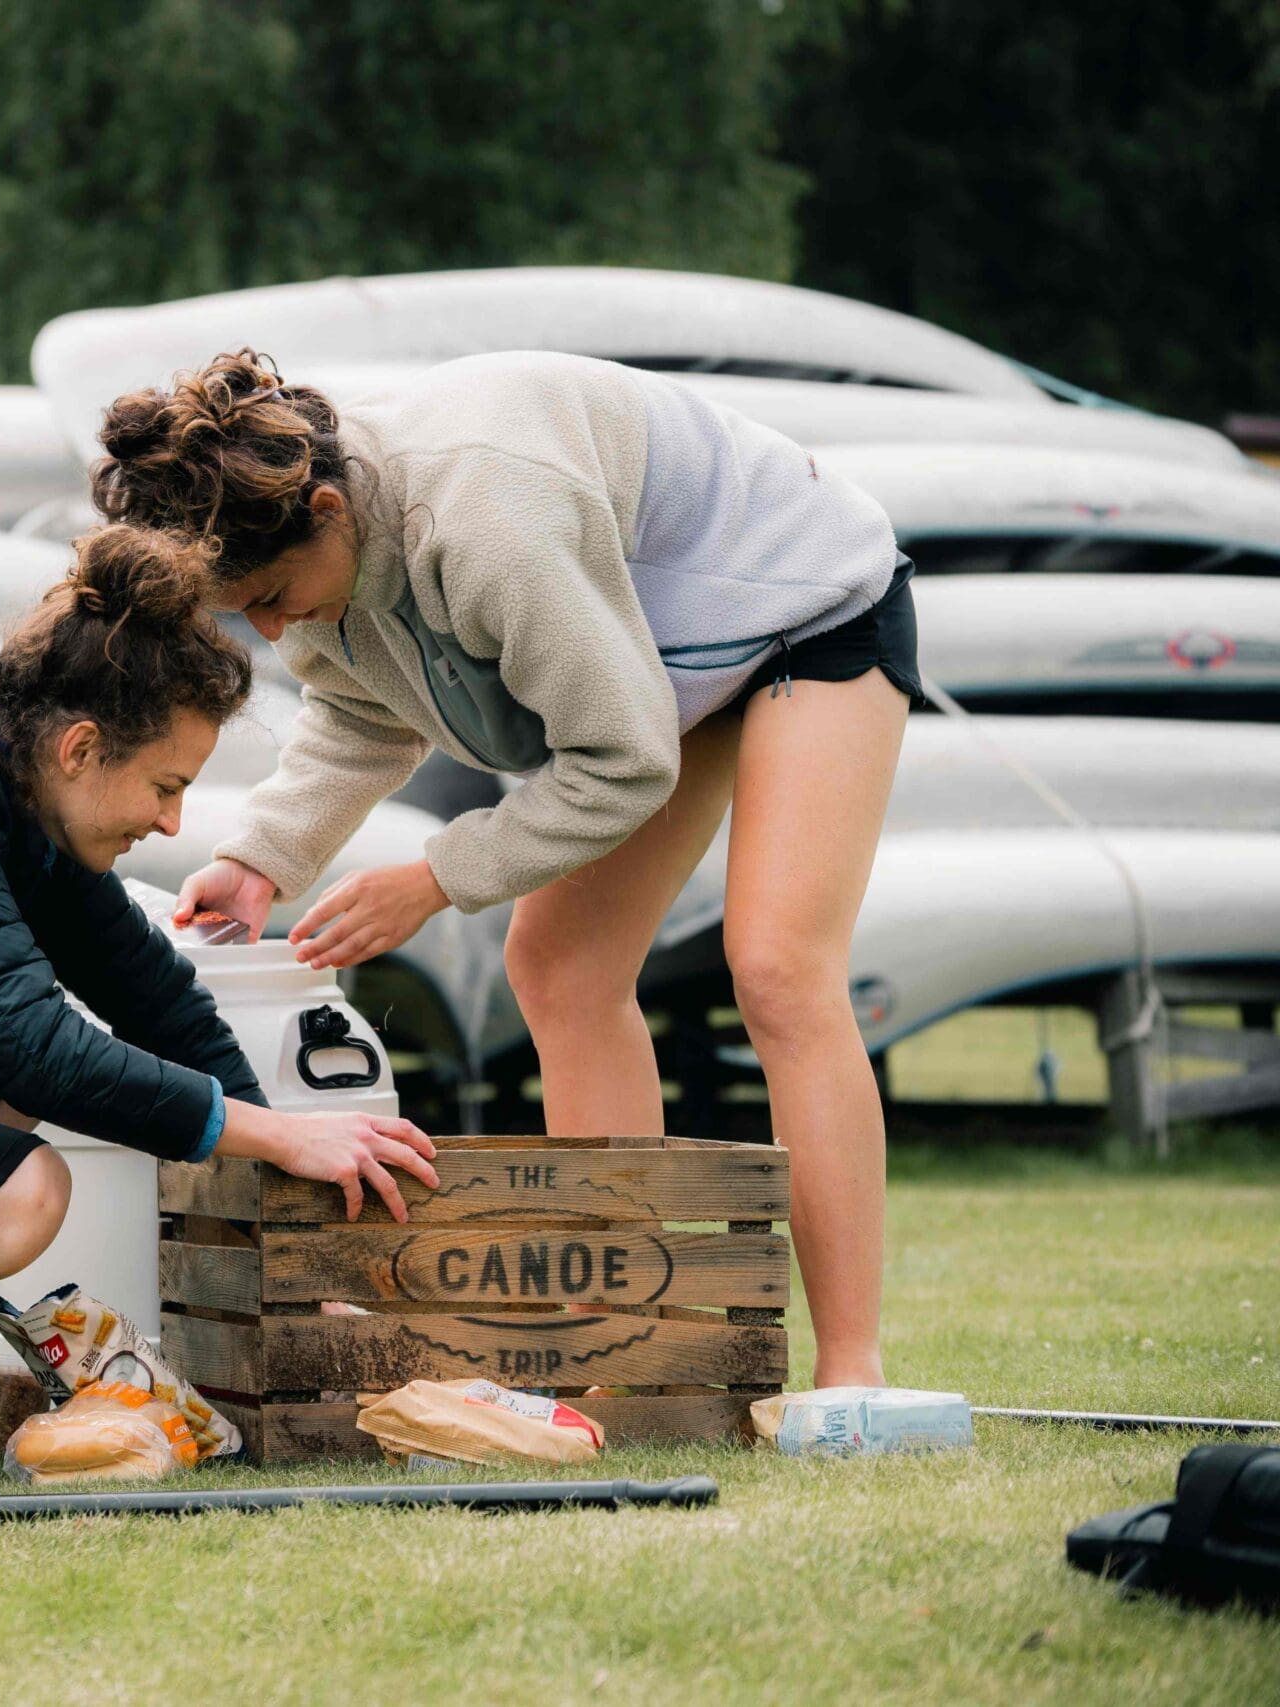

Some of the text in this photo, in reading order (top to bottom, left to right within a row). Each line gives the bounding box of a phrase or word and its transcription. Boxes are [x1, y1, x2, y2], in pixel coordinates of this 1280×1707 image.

[505, 1165, 558, 1190] THE
[437, 1242, 630, 1296] CANOE
[496, 1349, 562, 1376] TRIP
